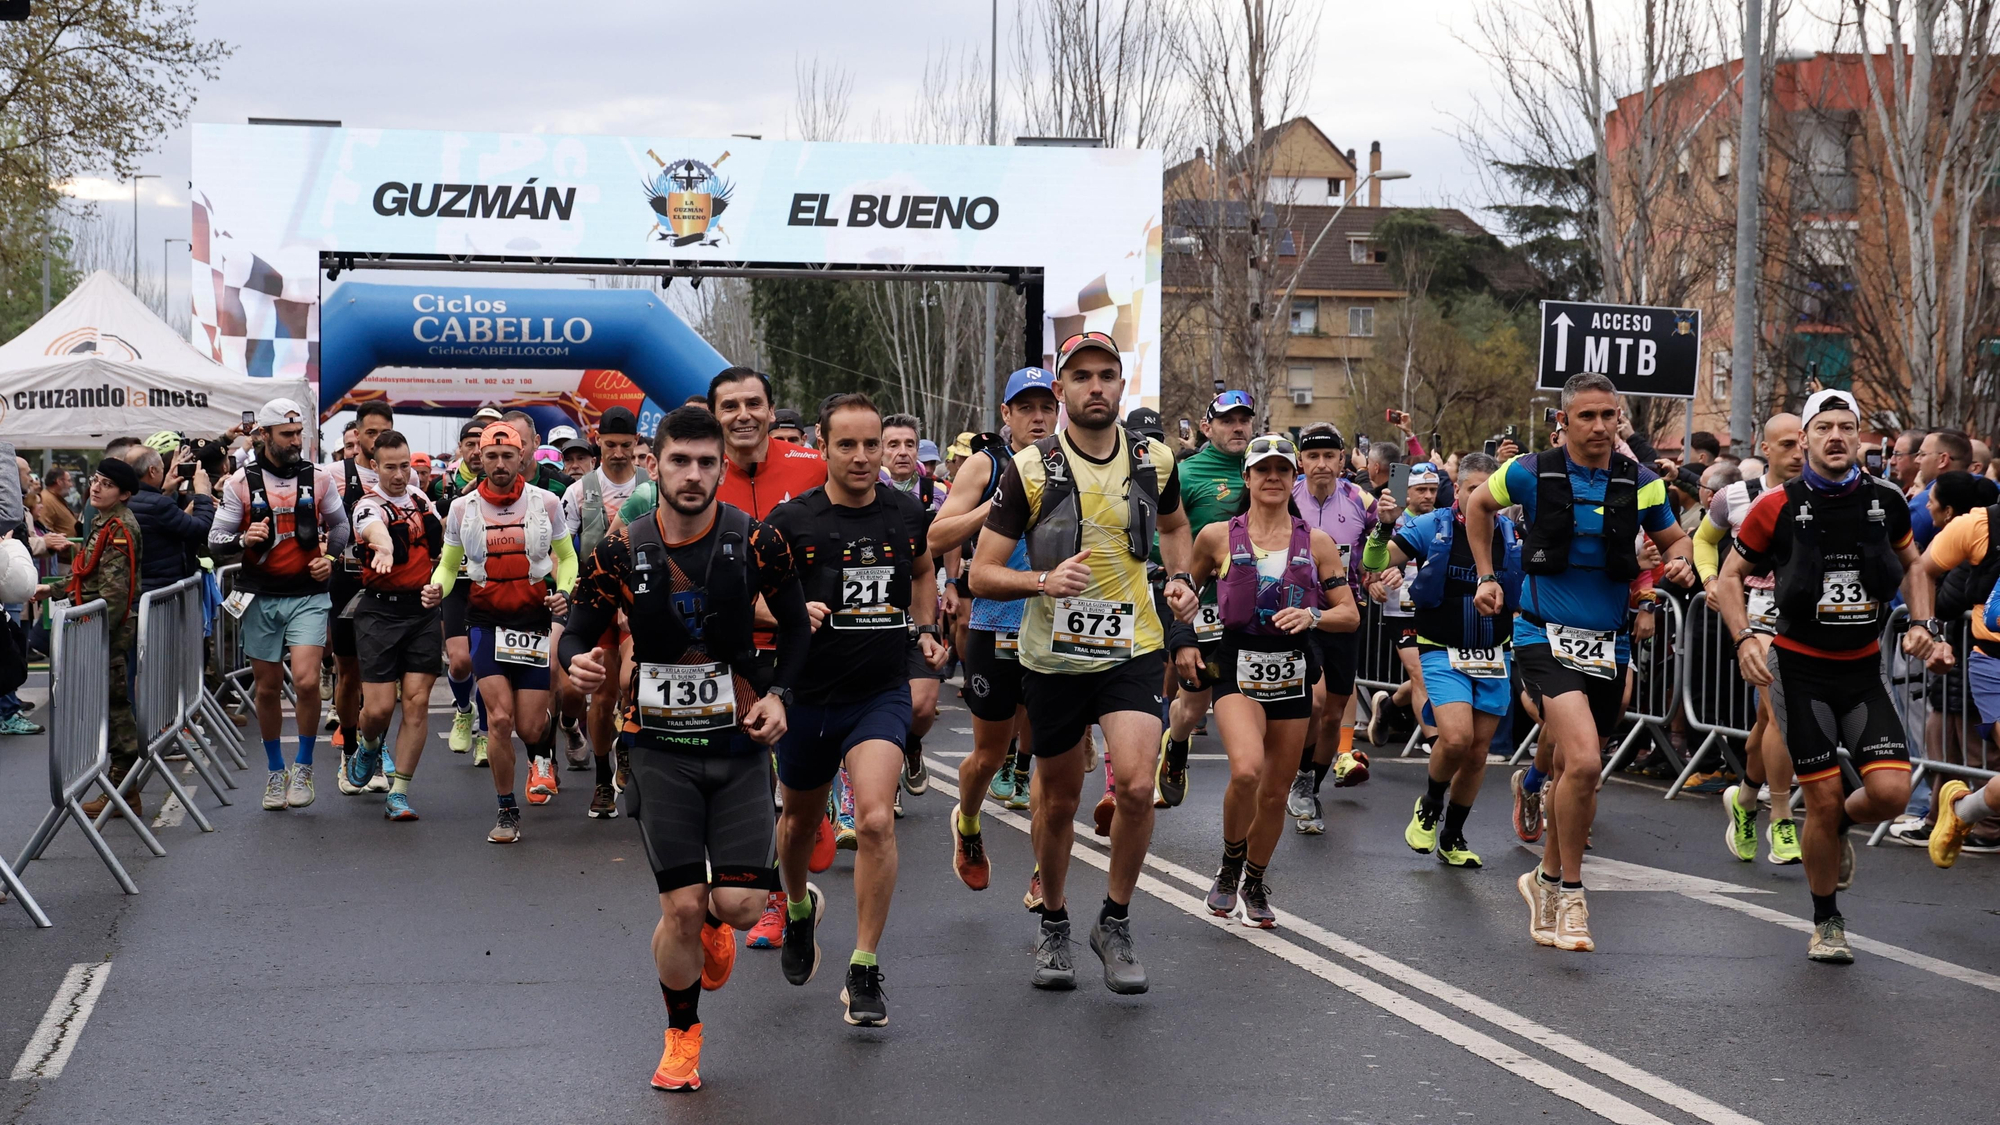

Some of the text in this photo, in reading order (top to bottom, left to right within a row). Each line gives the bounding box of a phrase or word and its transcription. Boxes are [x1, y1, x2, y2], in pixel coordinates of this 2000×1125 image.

[373, 177, 577, 220] GUZMÁN
[787, 193, 999, 230] EL BUENO
[412, 293, 507, 314] Ciclos
[412, 316, 593, 344] CABELLO
[1591, 312, 1652, 332] ACCESO
[428, 345, 569, 356] CiclosCABELLO.COM
[1583, 335, 1658, 376] MTB
[784, 449, 819, 460] Jimbee
[1829, 583, 1869, 604] 33
[1067, 611, 1122, 637] 673
[504, 632, 542, 649] 607
[1560, 638, 1605, 660] 524
[1457, 647, 1496, 661] 860
[1248, 662, 1296, 682] 393
[657, 679, 719, 706] 130
[1863, 742, 1905, 752] BENEMÉRITA
